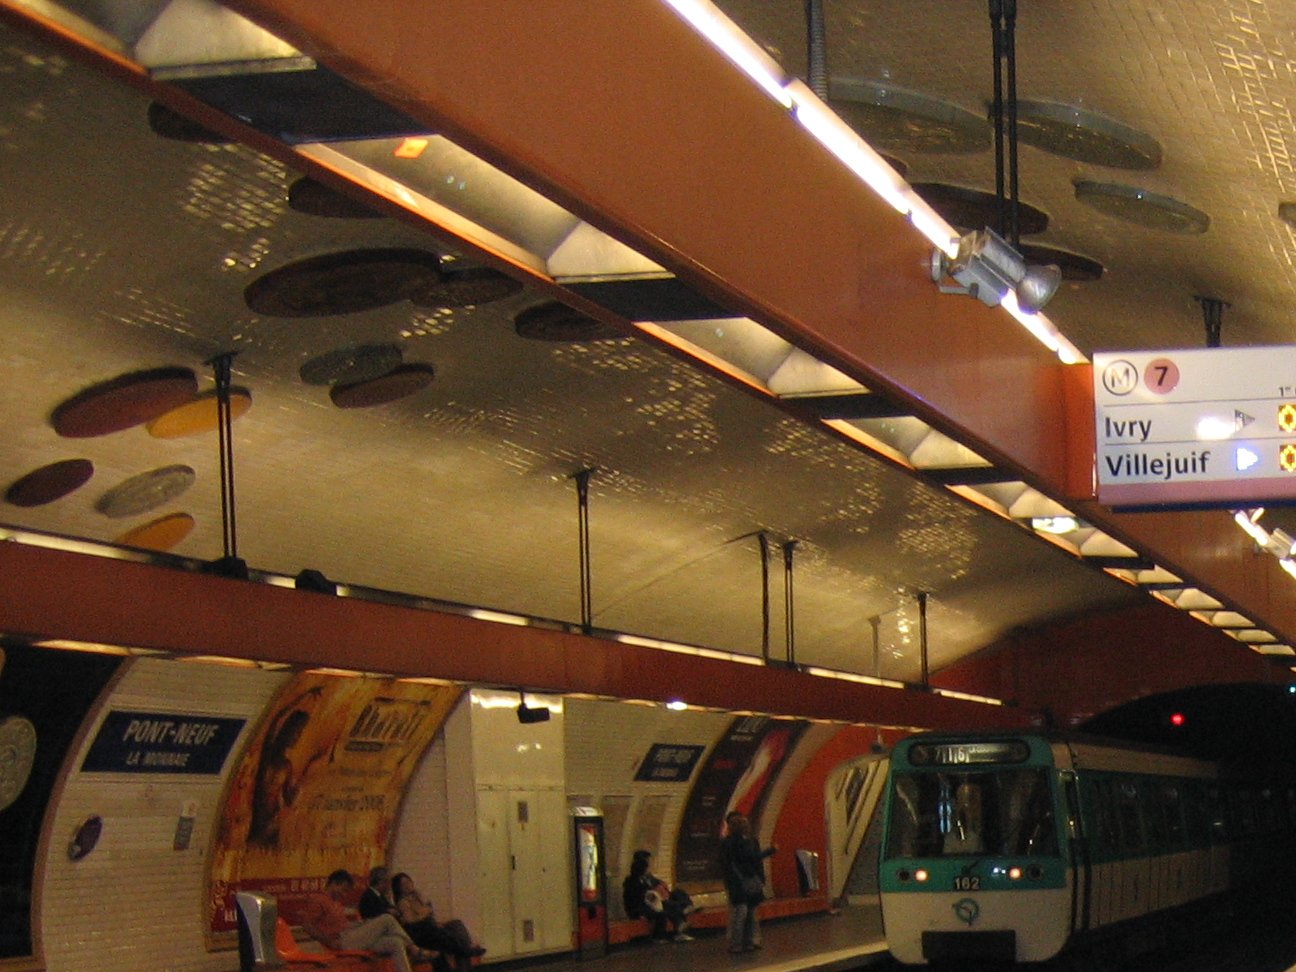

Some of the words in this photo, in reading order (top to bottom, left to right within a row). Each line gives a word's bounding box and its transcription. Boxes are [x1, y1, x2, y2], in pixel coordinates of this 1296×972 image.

[1154, 366, 1169, 387] 7
[1104, 416, 1152, 442] Ivry
[1105, 450, 1211, 480] Villejuif
[122, 719, 220, 746] PONT-NEUF
